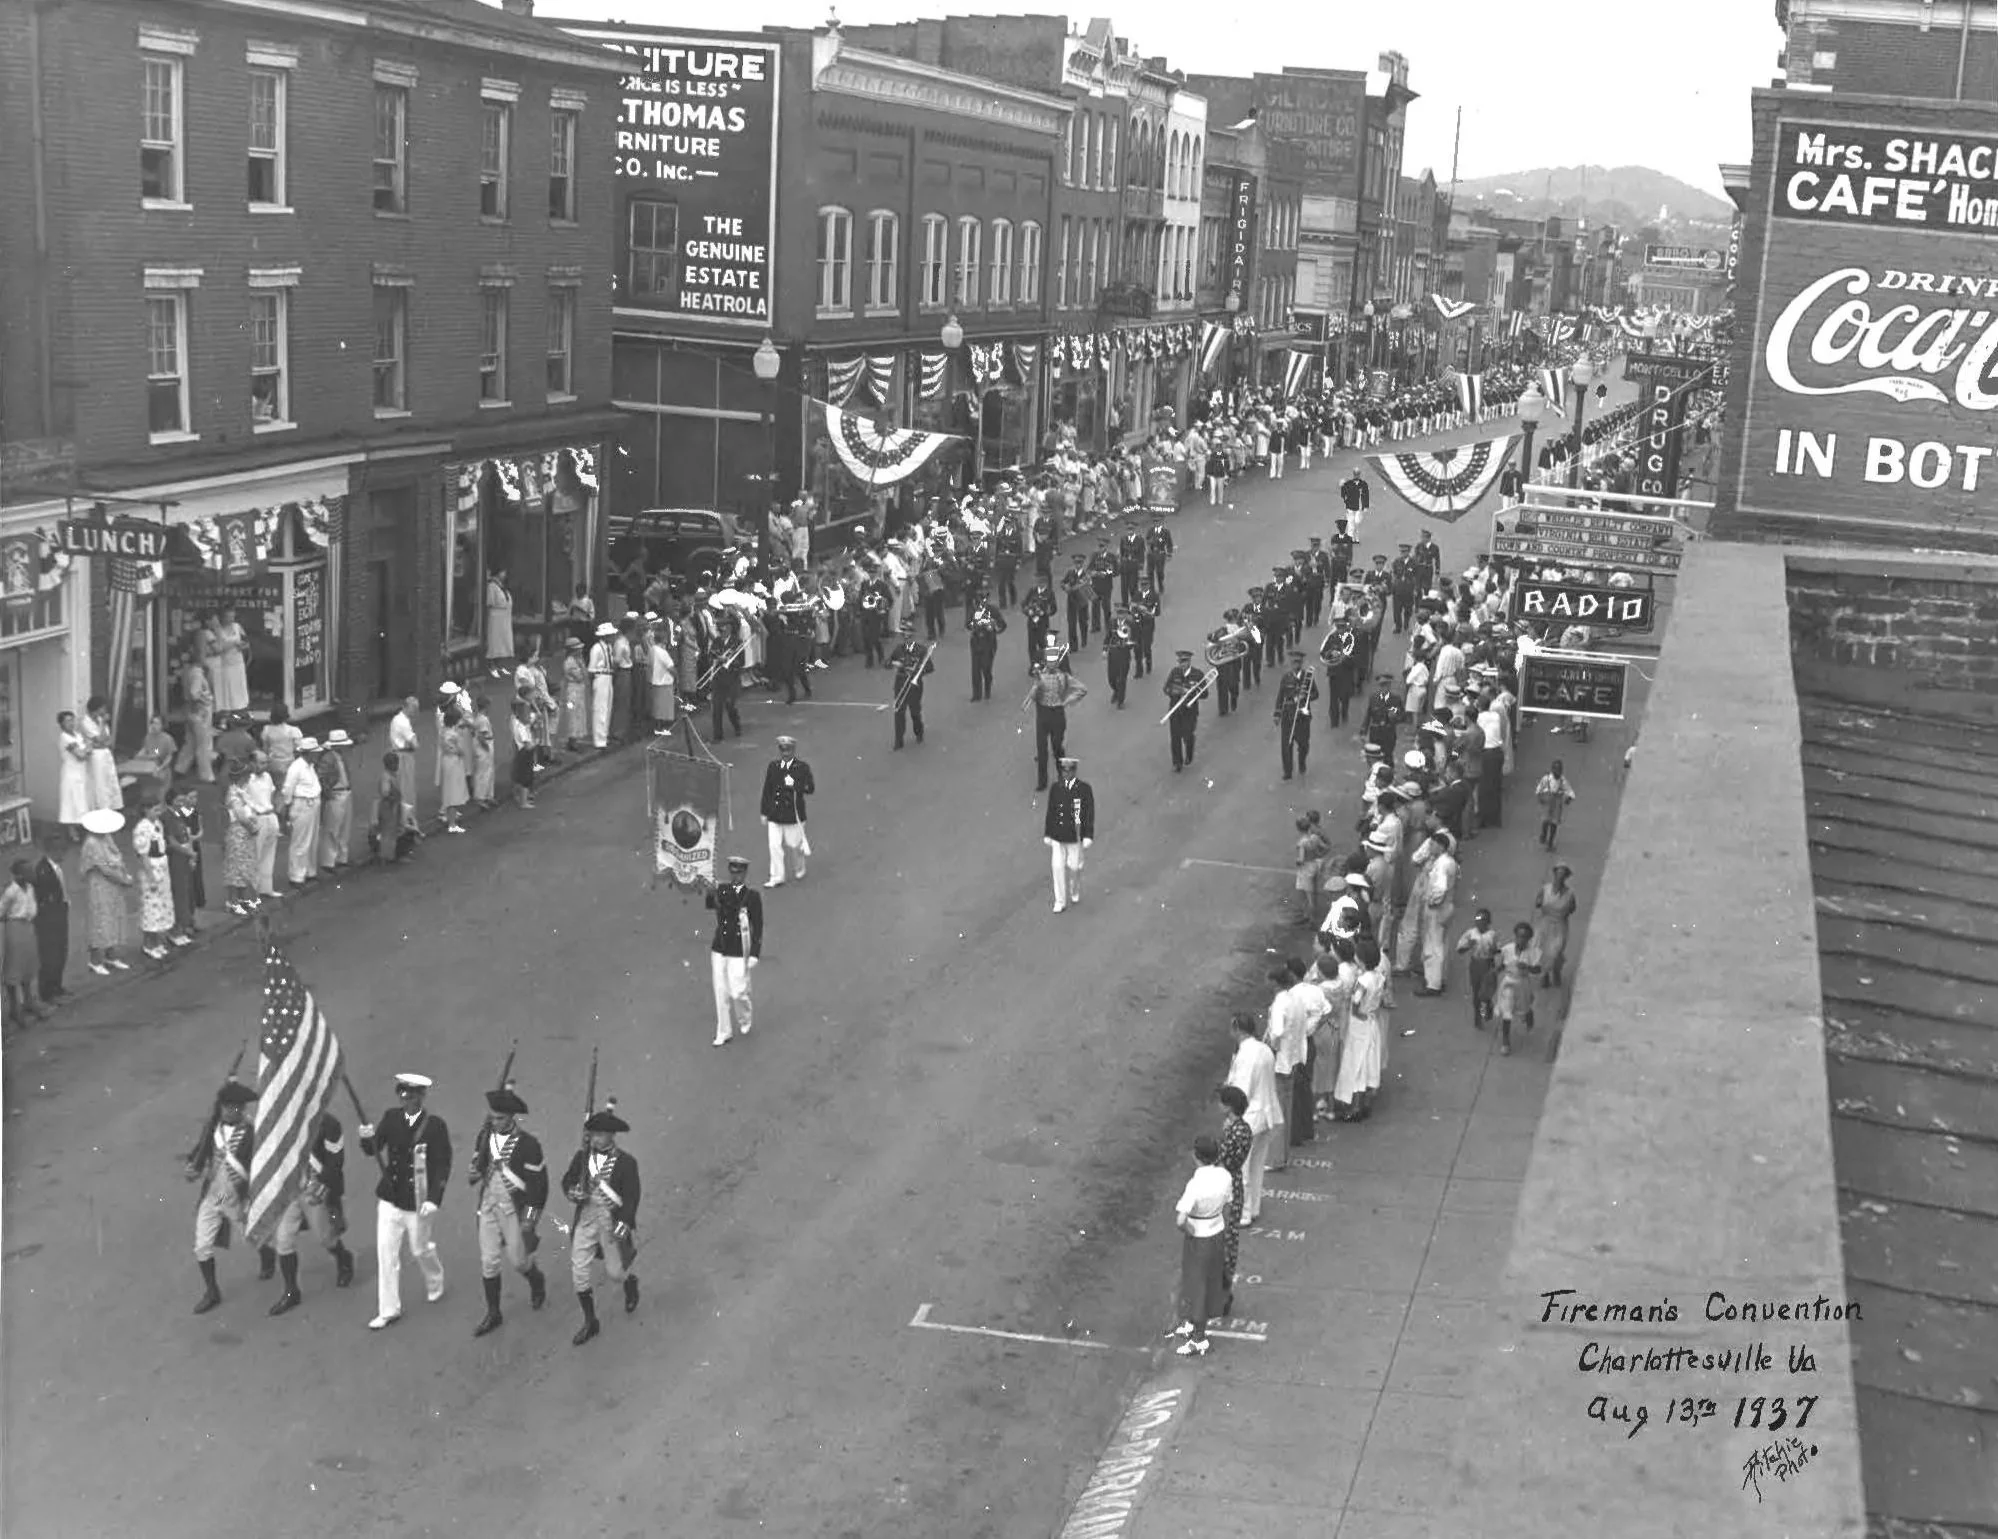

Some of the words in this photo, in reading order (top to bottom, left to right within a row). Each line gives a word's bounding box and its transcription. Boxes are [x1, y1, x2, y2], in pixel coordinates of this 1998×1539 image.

[665, 79, 680, 94] IS
[1796, 132, 1872, 170] Mrs.
[1884, 139, 1998, 181] SHAC
[703, 215, 744, 237] THE
[1231, 182, 1251, 296] FRIGIDAIR
[686, 240, 765, 264] GENUINE
[685, 266, 760, 290] ESTATE
[680, 291, 767, 315] HEATROLA
[1629, 362, 1702, 380] MONTICELLO
[1647, 385, 1671, 473] DRUG
[1775, 429, 1837, 478] IN
[1864, 437, 1998, 492] BOT
[66, 526, 155, 556] LUNCH
[1523, 590, 1643, 621] RADIO
[1534, 681, 1613, 706] CAFE
[1289, 1157, 1333, 1170] OUR
